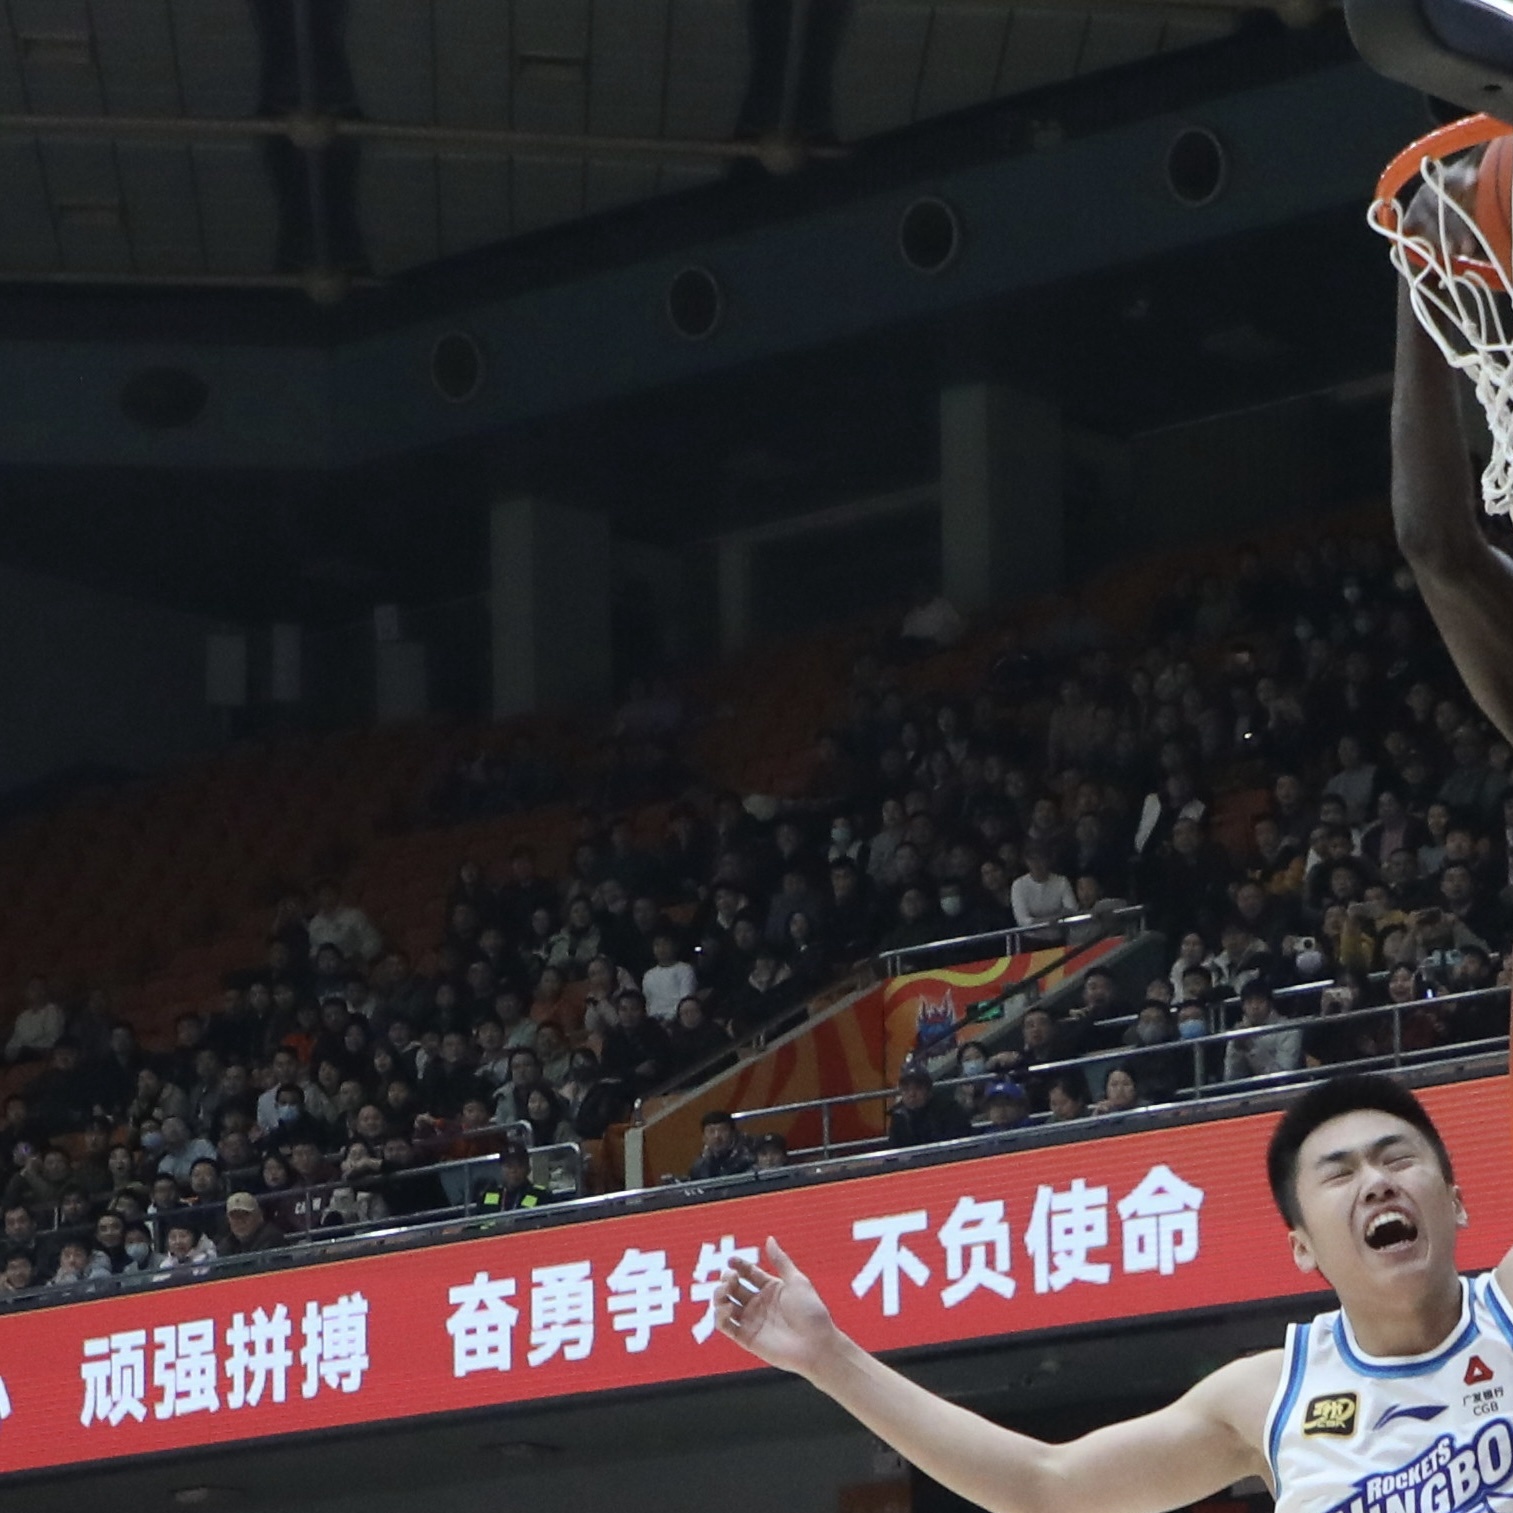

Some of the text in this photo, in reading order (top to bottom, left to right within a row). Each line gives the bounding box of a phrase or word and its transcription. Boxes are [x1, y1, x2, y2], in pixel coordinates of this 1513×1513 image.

[79, 1292, 369, 1428] 顽强拼搏
[851, 1164, 1204, 1317] 不负使命
[1366, 1436, 1452, 1504] ROCKETS
